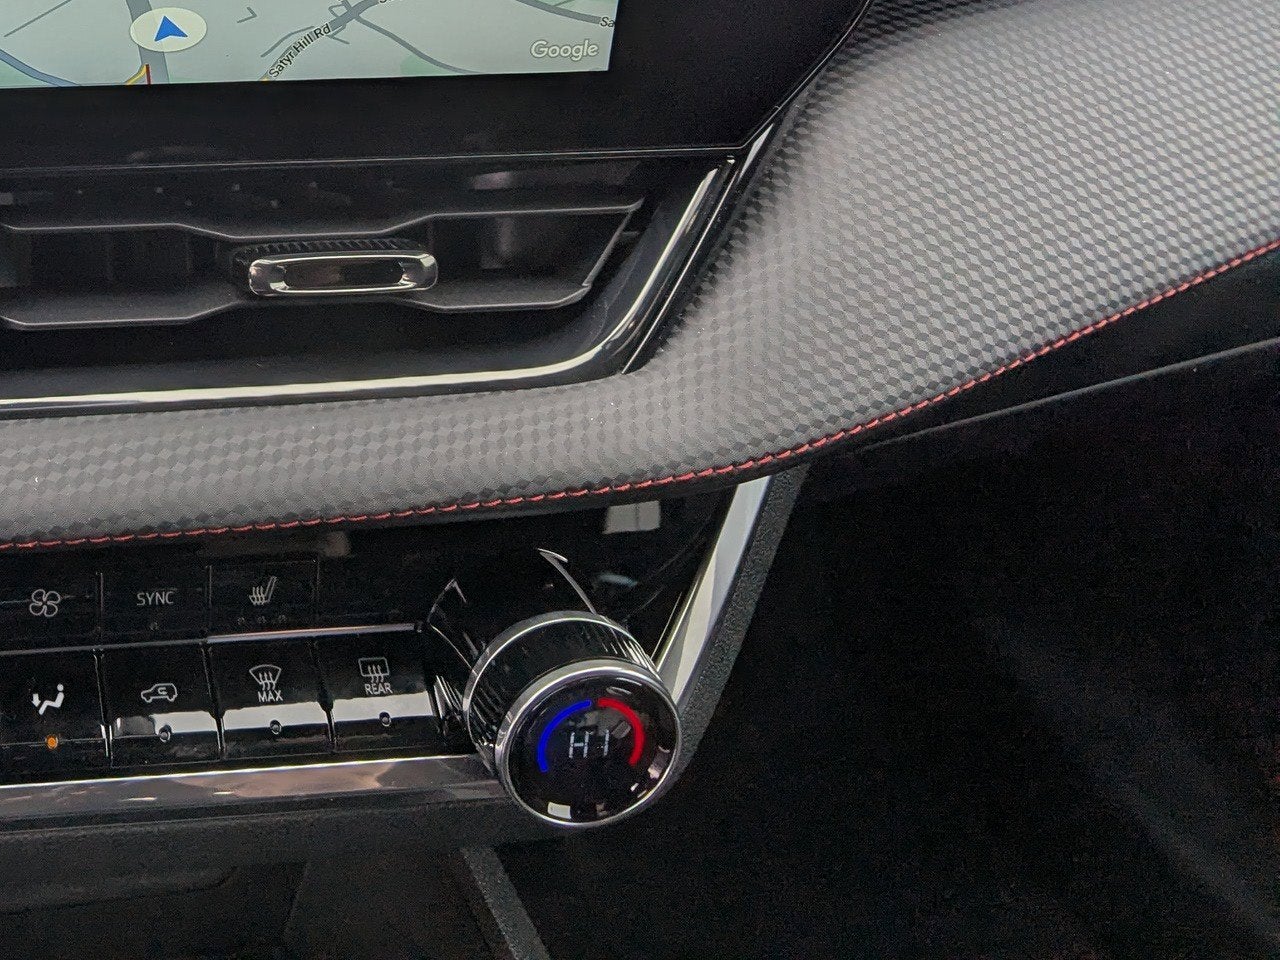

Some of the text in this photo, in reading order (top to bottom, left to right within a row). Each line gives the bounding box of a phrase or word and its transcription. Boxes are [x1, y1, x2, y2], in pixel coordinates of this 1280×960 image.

[269, 23, 331, 79] Satyr Hill Rd
[530, 39, 599, 62] Google
[135, 590, 175, 607] SYNC
[256, 689, 284, 703] MAX
[363, 681, 393, 696] REAR
